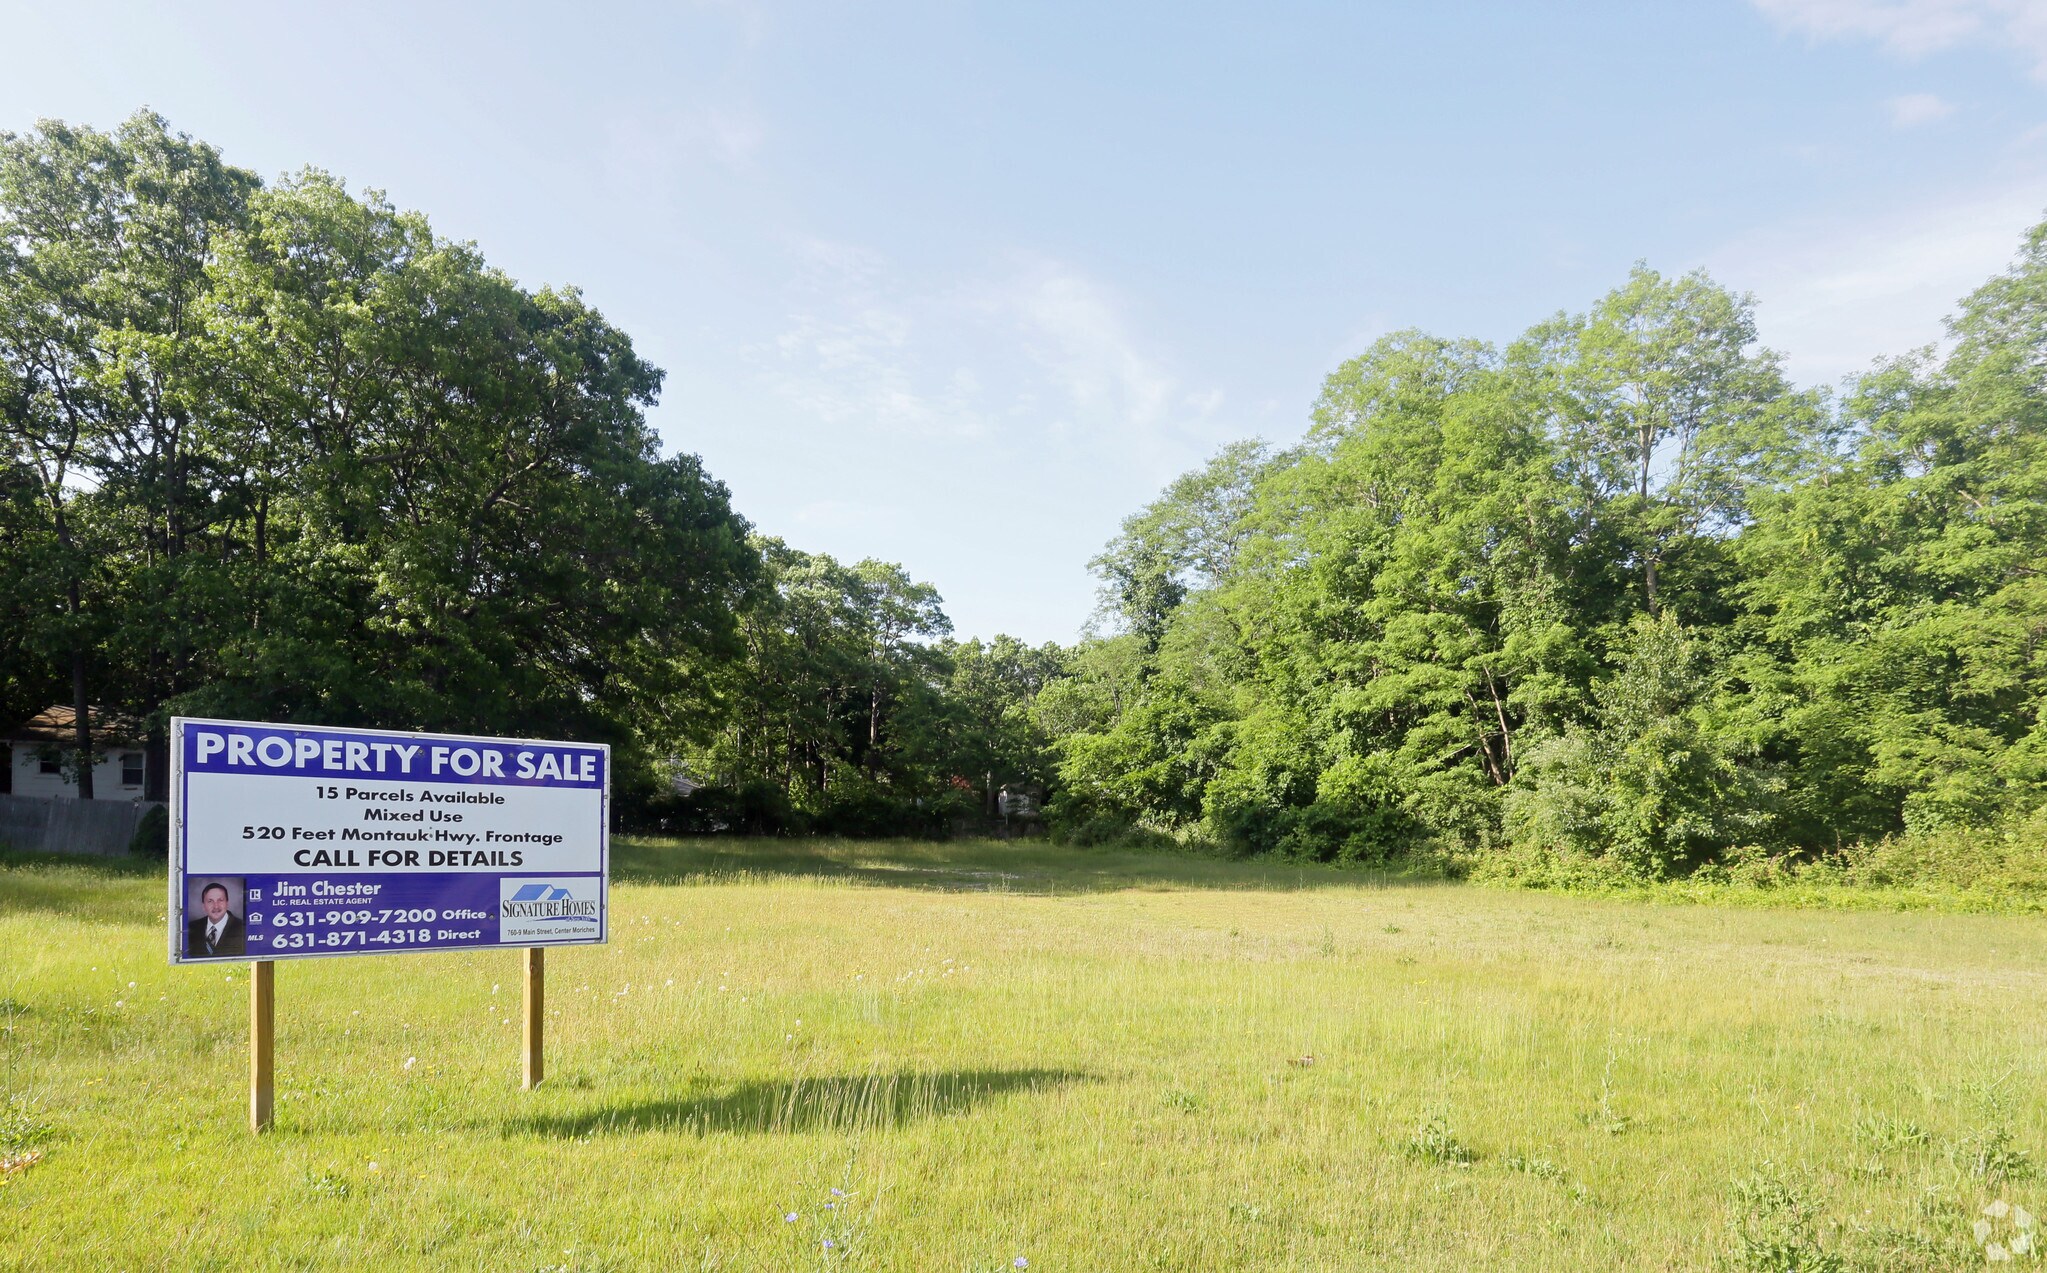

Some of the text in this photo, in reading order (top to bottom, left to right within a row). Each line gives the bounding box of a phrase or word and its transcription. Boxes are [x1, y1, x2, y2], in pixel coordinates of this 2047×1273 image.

[196, 732, 597, 783] PROPERTY FOR SALE
[316, 785, 505, 806] 15 Parcels Available
[363, 808, 463, 824] Mixed Use
[242, 825, 563, 846] 520 Feet Montauk Hwy. Frontage
[293, 849, 524, 868] CALL FOR DETAILS
[273, 880, 381, 896] Jim Chester
[272, 898, 288, 906] LIC.
[290, 898, 311, 906] REAL
[346, 897, 372, 905] AGENT
[502, 898, 596, 918] SIGNATURE HOMES
[272, 908, 487, 927] 631-909-7200 Office
[272, 929, 481, 949] 631-871-4318 Direct
[554, 927, 572, 935] Center
[572, 926, 595, 934] Moriches
